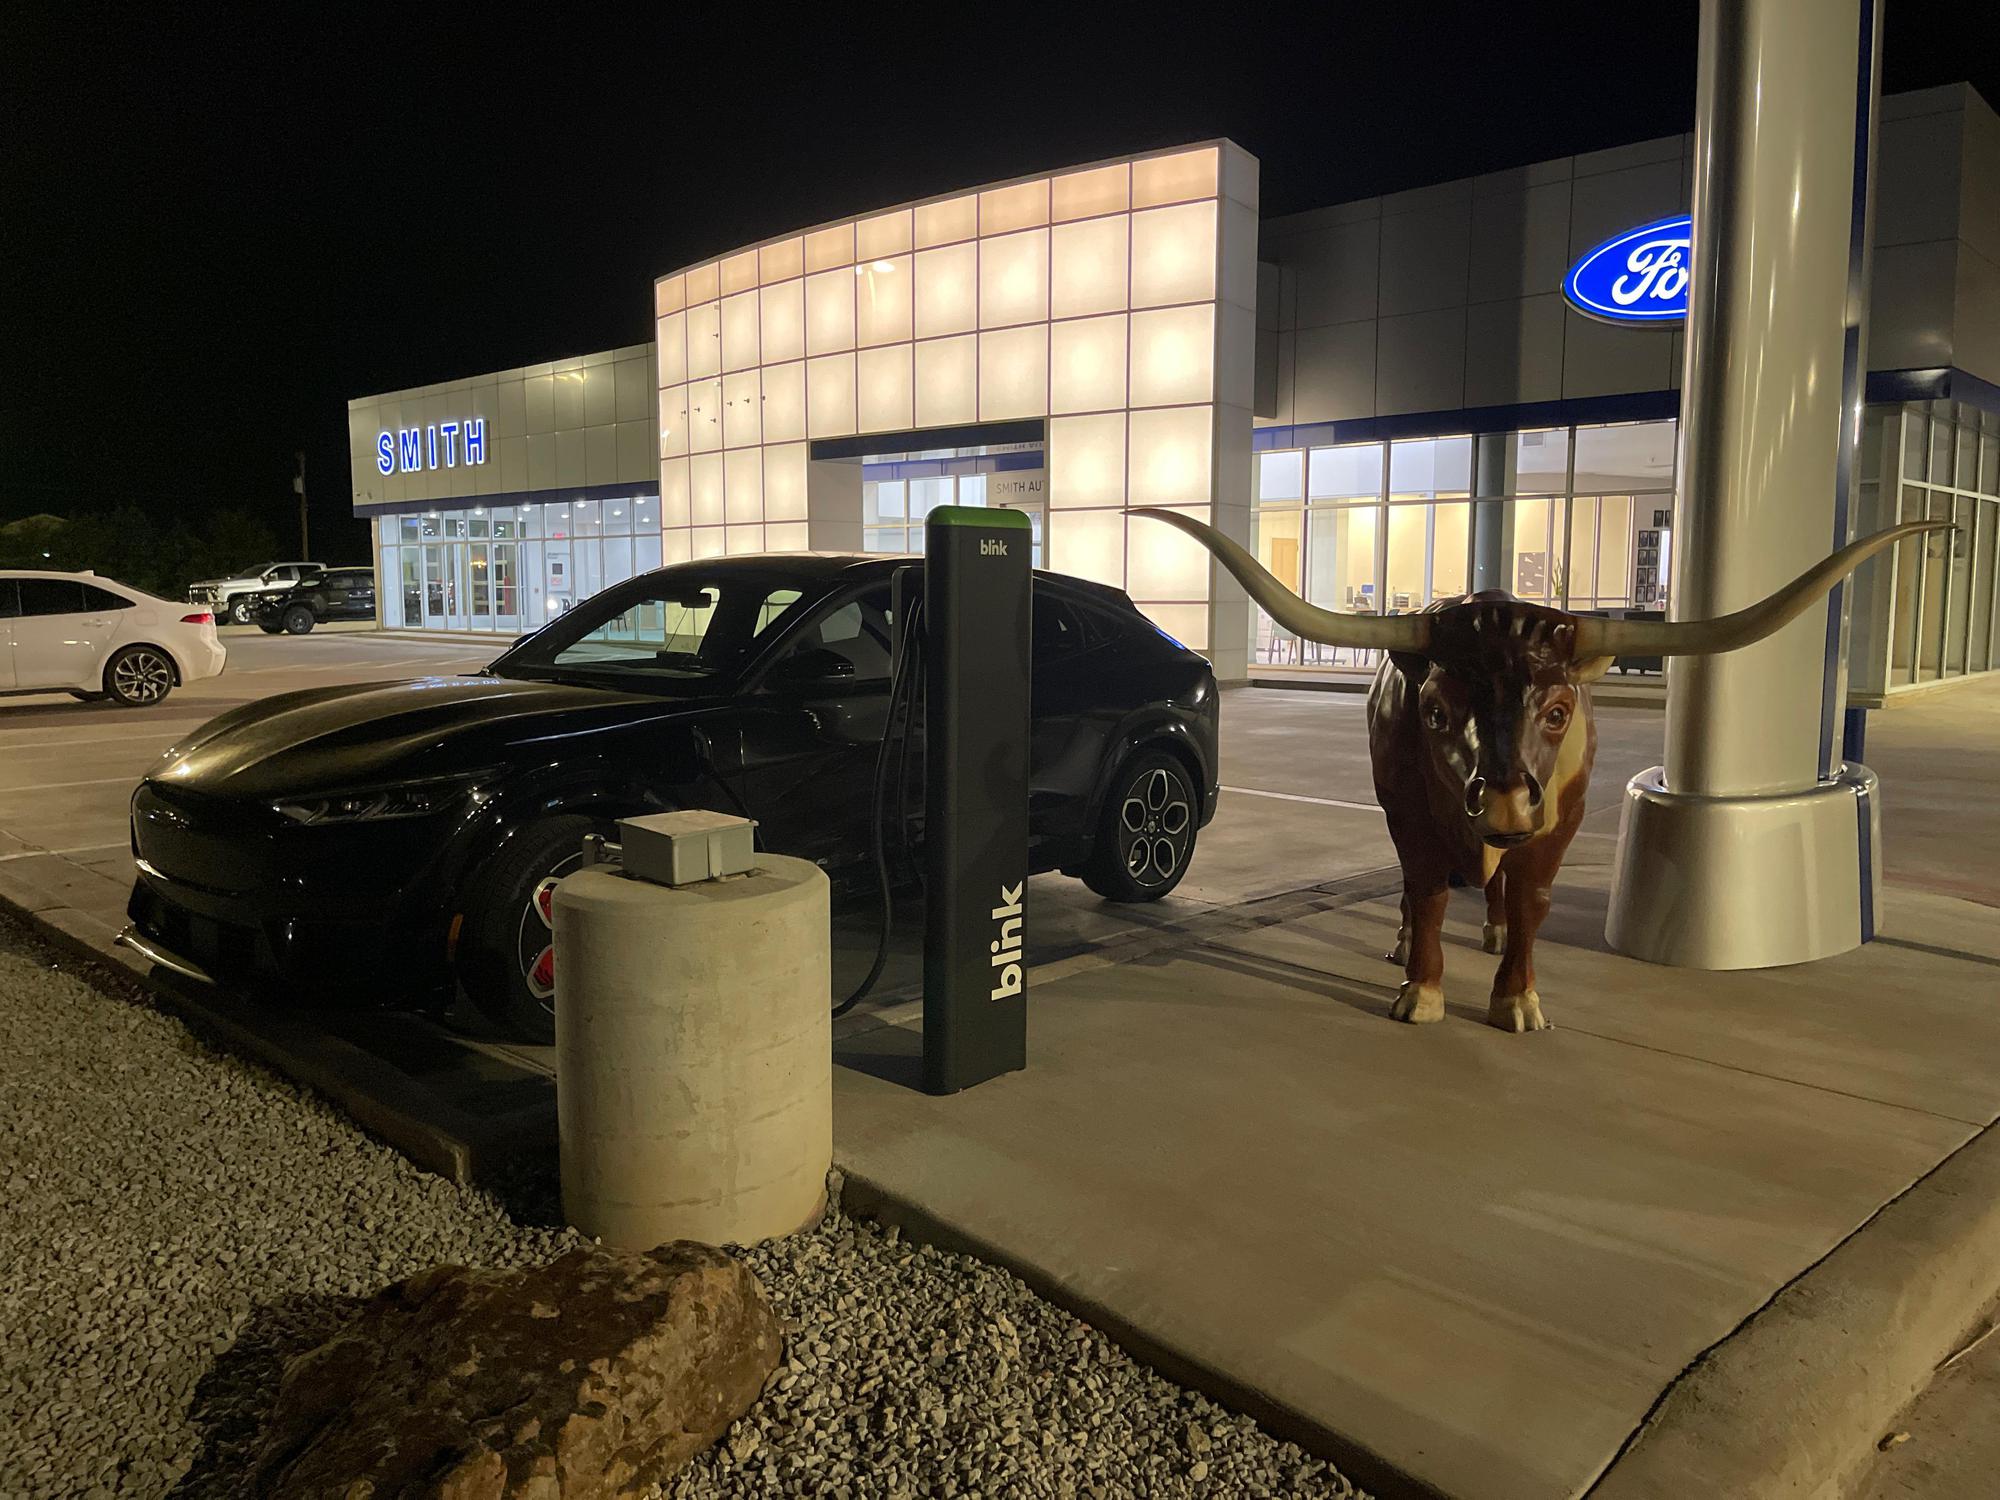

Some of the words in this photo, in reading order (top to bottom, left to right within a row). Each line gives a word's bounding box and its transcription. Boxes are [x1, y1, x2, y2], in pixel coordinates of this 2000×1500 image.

[1611, 239, 1691, 305] Fo
[377, 418, 485, 475] SMITH
[996, 481, 1026, 494] SMITH
[1028, 480, 1044, 492] AU
[980, 539, 1008, 556] blink
[990, 880, 1023, 1001] blink
